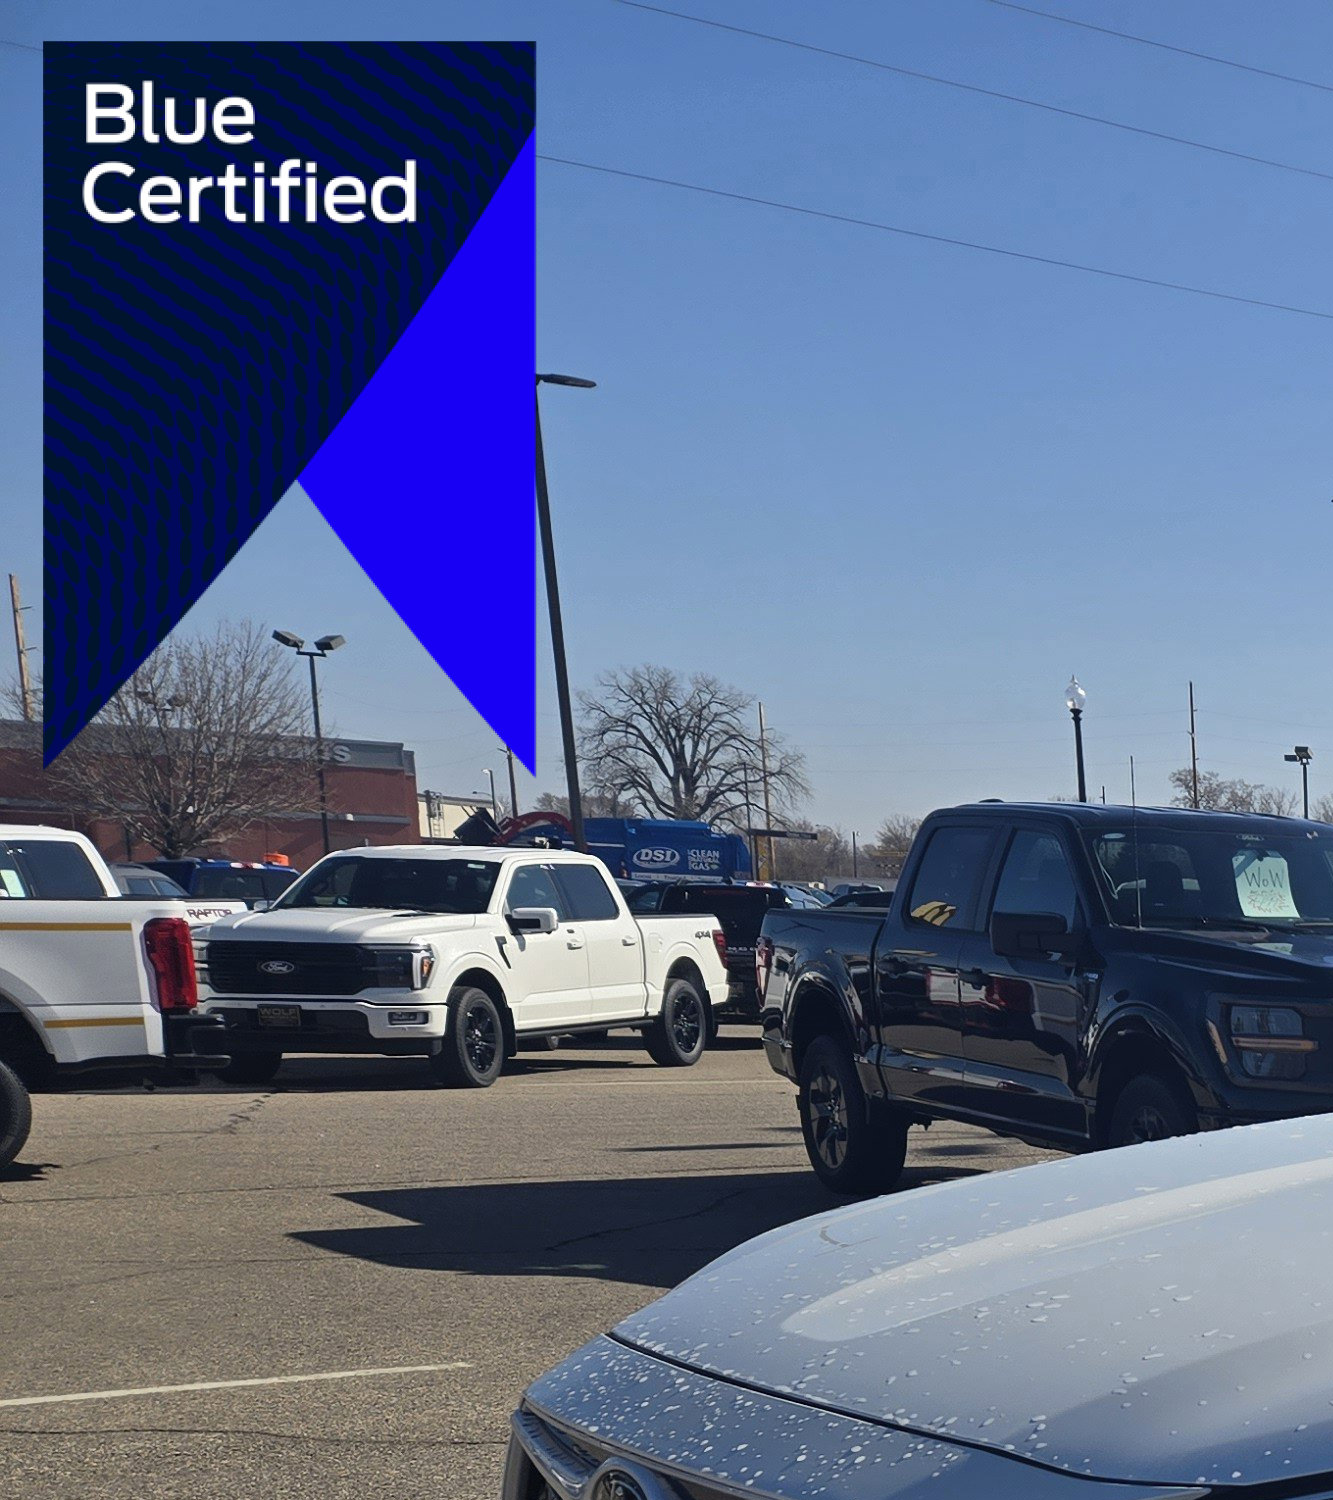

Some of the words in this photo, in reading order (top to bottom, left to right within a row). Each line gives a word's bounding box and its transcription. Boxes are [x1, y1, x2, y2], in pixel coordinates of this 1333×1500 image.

[639, 848, 673, 862] DSI
[690, 849, 720, 858] CLEAN
[187, 908, 232, 919] RAPTOR
[259, 1007, 297, 1016] WOLF
